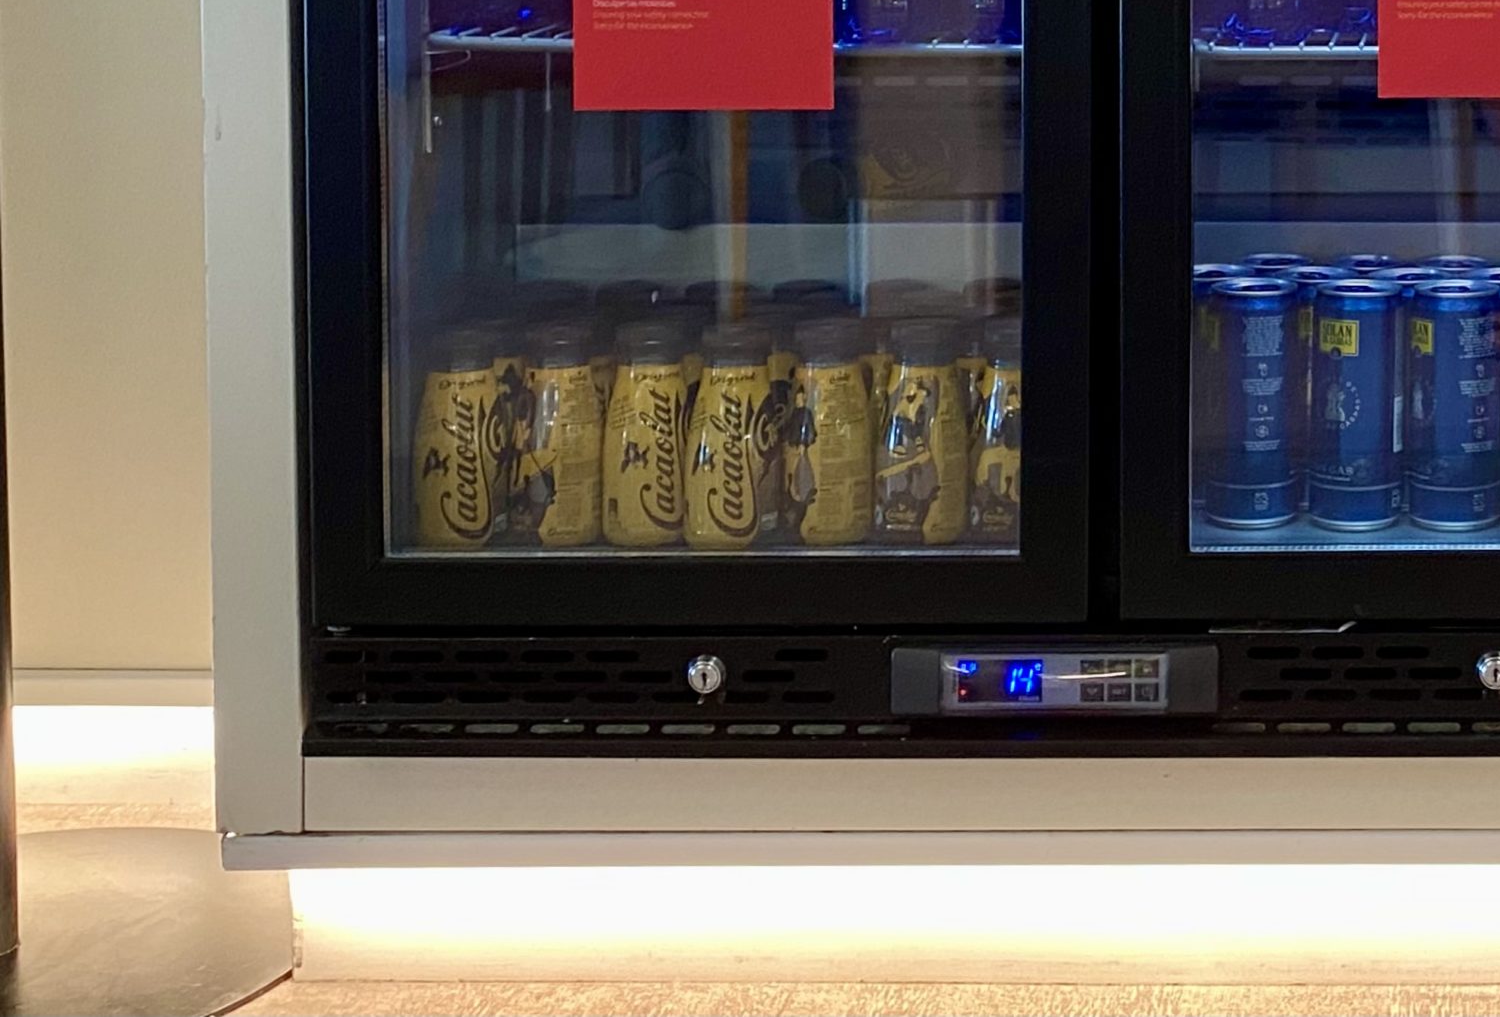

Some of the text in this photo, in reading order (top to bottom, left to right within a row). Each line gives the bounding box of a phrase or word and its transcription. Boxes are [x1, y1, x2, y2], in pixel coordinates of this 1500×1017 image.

[639, 387, 685, 531] Cacaolat
[706, 390, 759, 538] Cacaolat
[1009, 668, 1034, 693] 14
